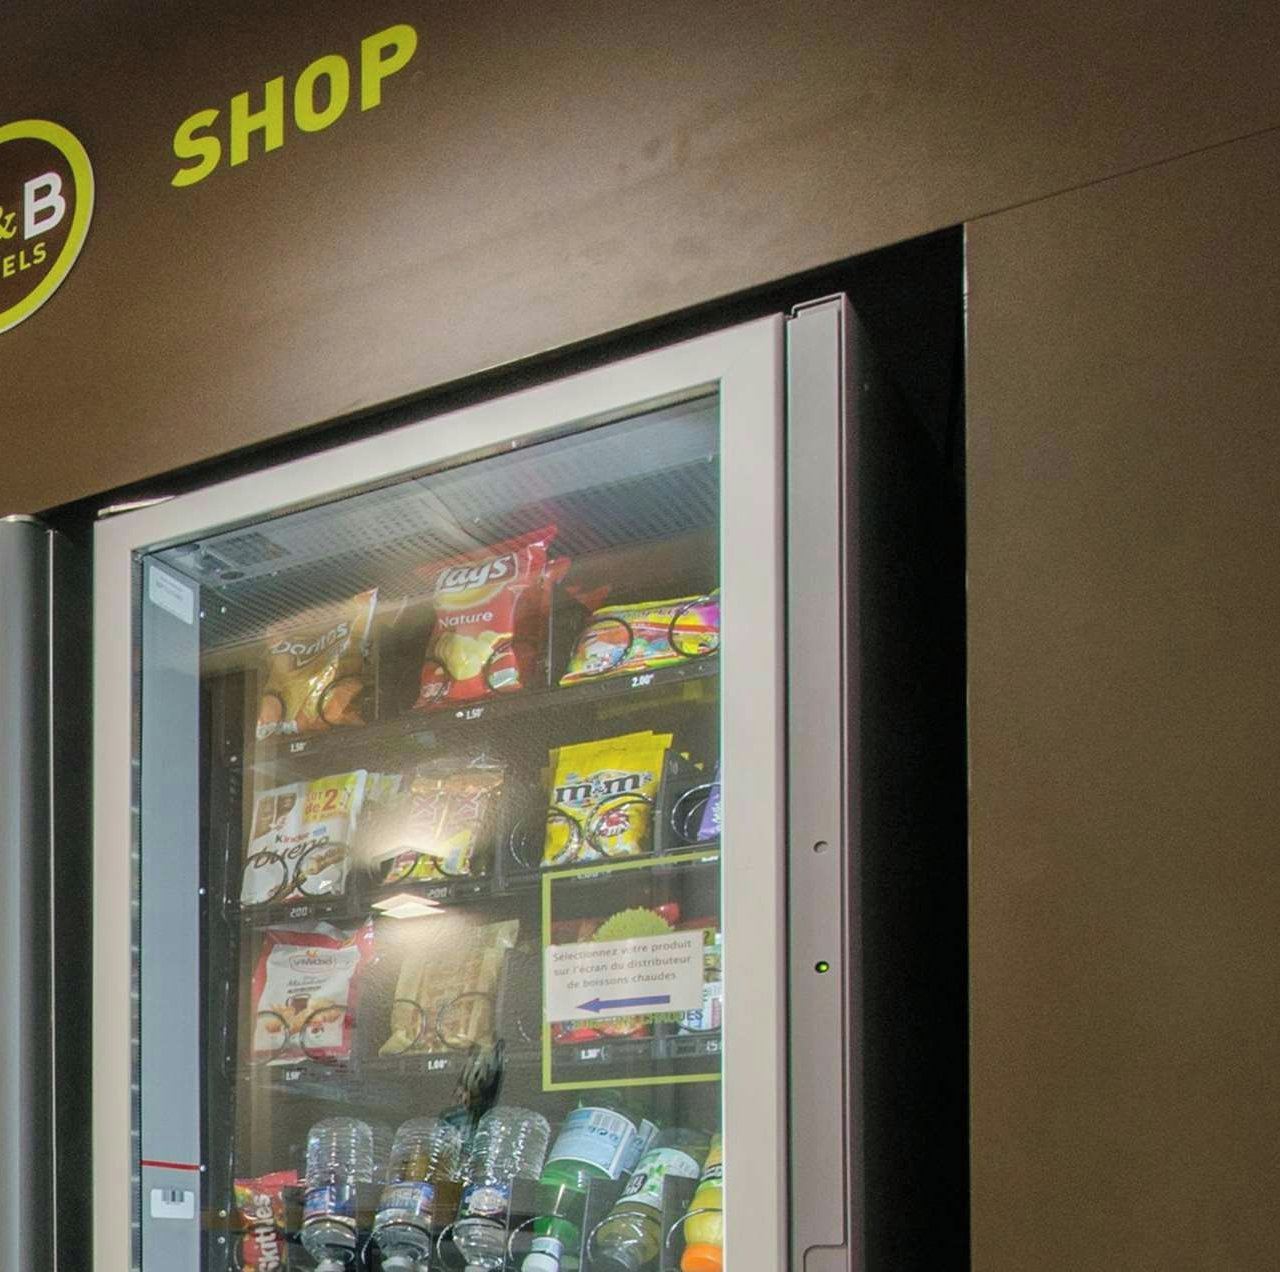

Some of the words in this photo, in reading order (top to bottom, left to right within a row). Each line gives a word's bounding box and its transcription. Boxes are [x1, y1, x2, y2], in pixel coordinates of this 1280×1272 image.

[170, 23, 419, 188] SHOP
[438, 611, 494, 629] Nature
[271, 622, 349, 655] Doritos
[553, 947, 618, 962] Sélectionnez
[621, 944, 648, 955] vtre
[651, 939, 692, 952] produit
[554, 967, 570, 977] sur
[610, 960, 625, 971] du
[626, 954, 692, 970] distributeur
[566, 980, 580, 990] de
[582, 976, 629, 989] boissons
[631, 971, 677, 984] chaudes
